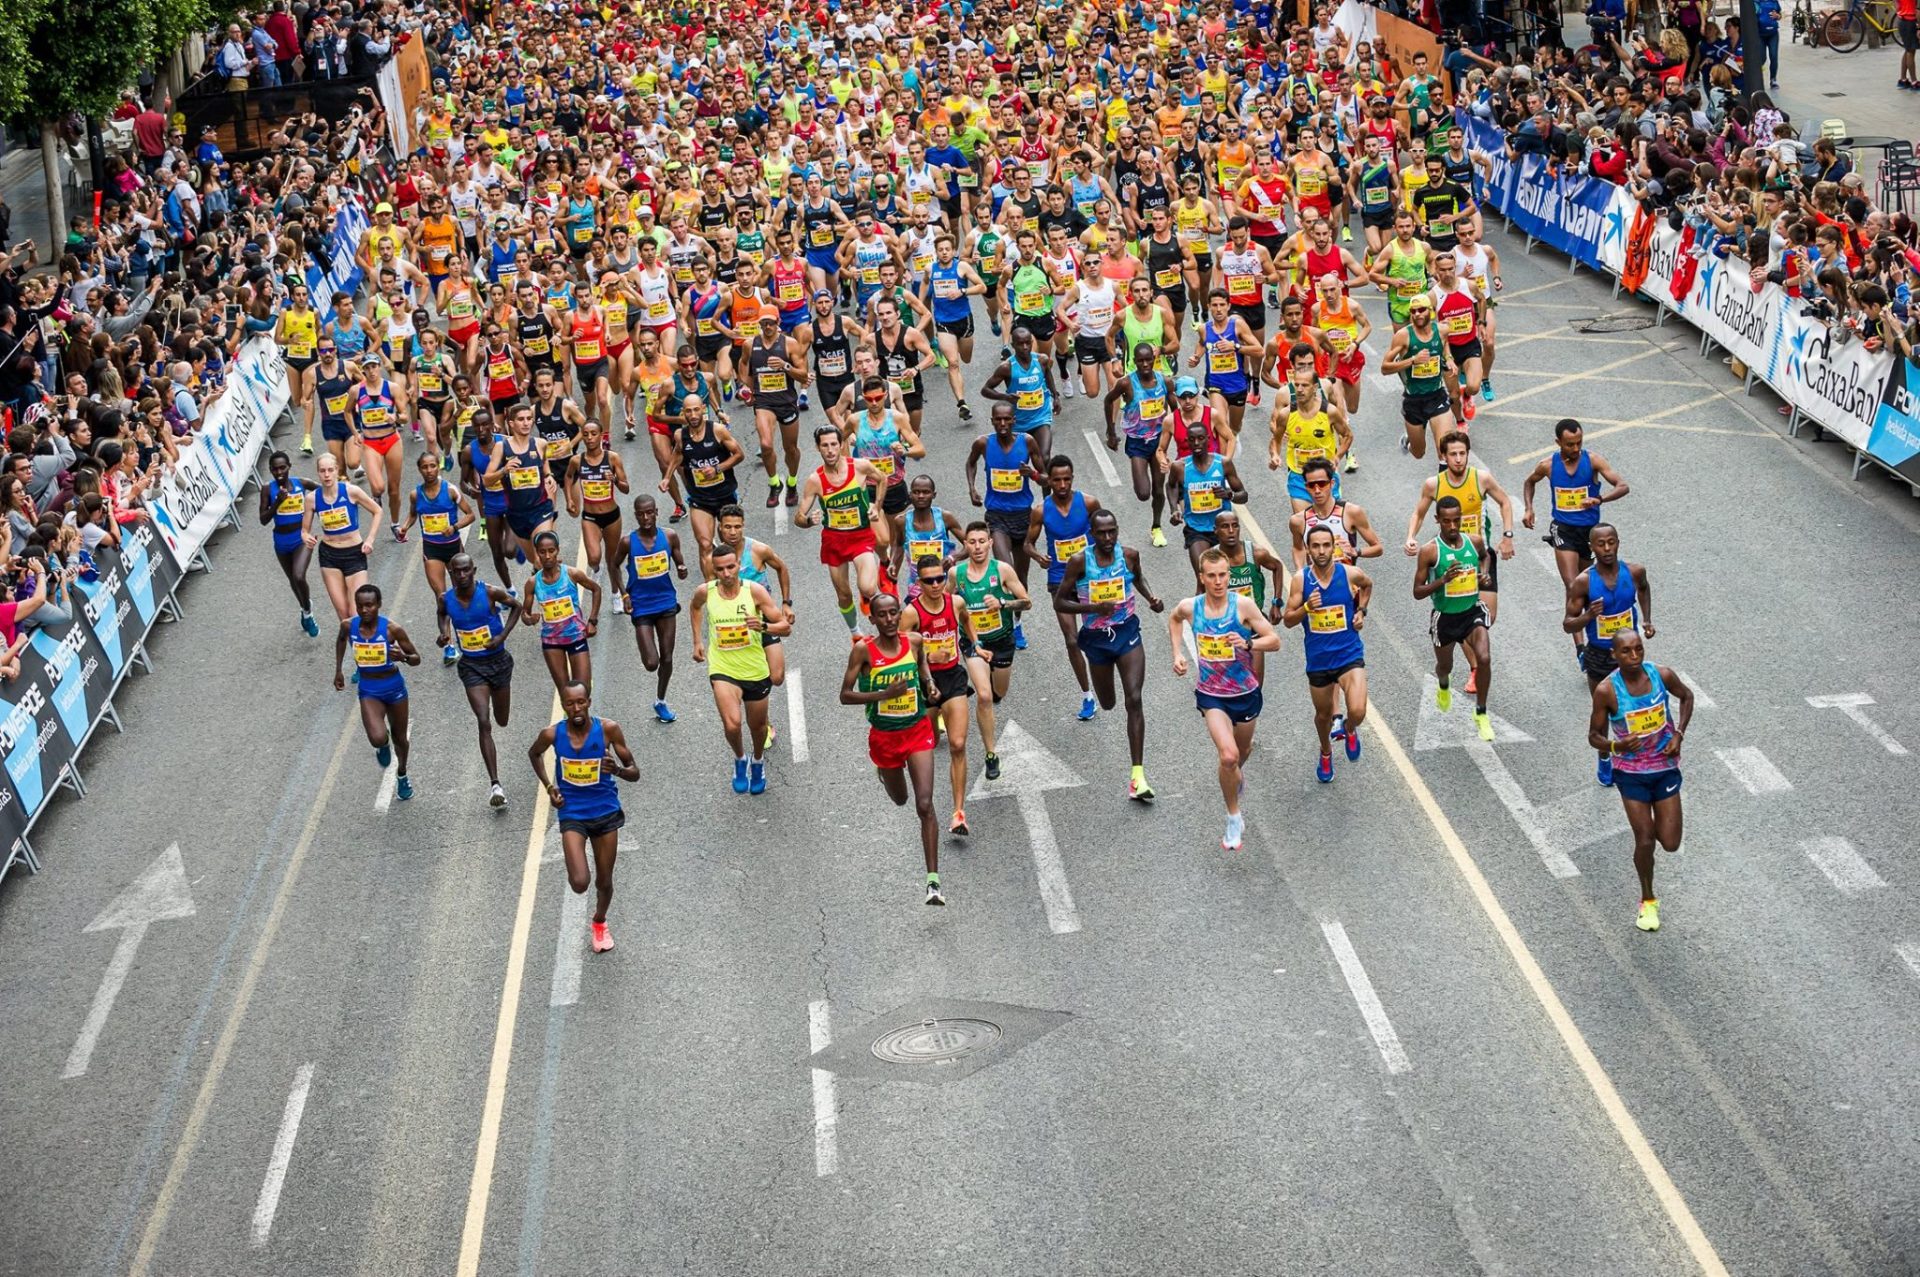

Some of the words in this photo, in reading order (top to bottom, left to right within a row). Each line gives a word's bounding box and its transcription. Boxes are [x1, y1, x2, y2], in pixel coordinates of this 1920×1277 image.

[1023, 147, 1043, 157] ITALIA
[1149, 198, 1165, 206] GAES
[1714, 270, 1769, 350] CaixaBank
[826, 348, 845, 359] GAES
[546, 431, 568, 441] GAES
[697, 456, 719, 468] GAES
[828, 493, 858, 508] BIKILA
[1228, 576, 1253, 586] NZANIA
[84, 566, 121, 627] POWERADE
[736, 604, 747, 614] LS
[44, 621, 87, 688] POWERADE
